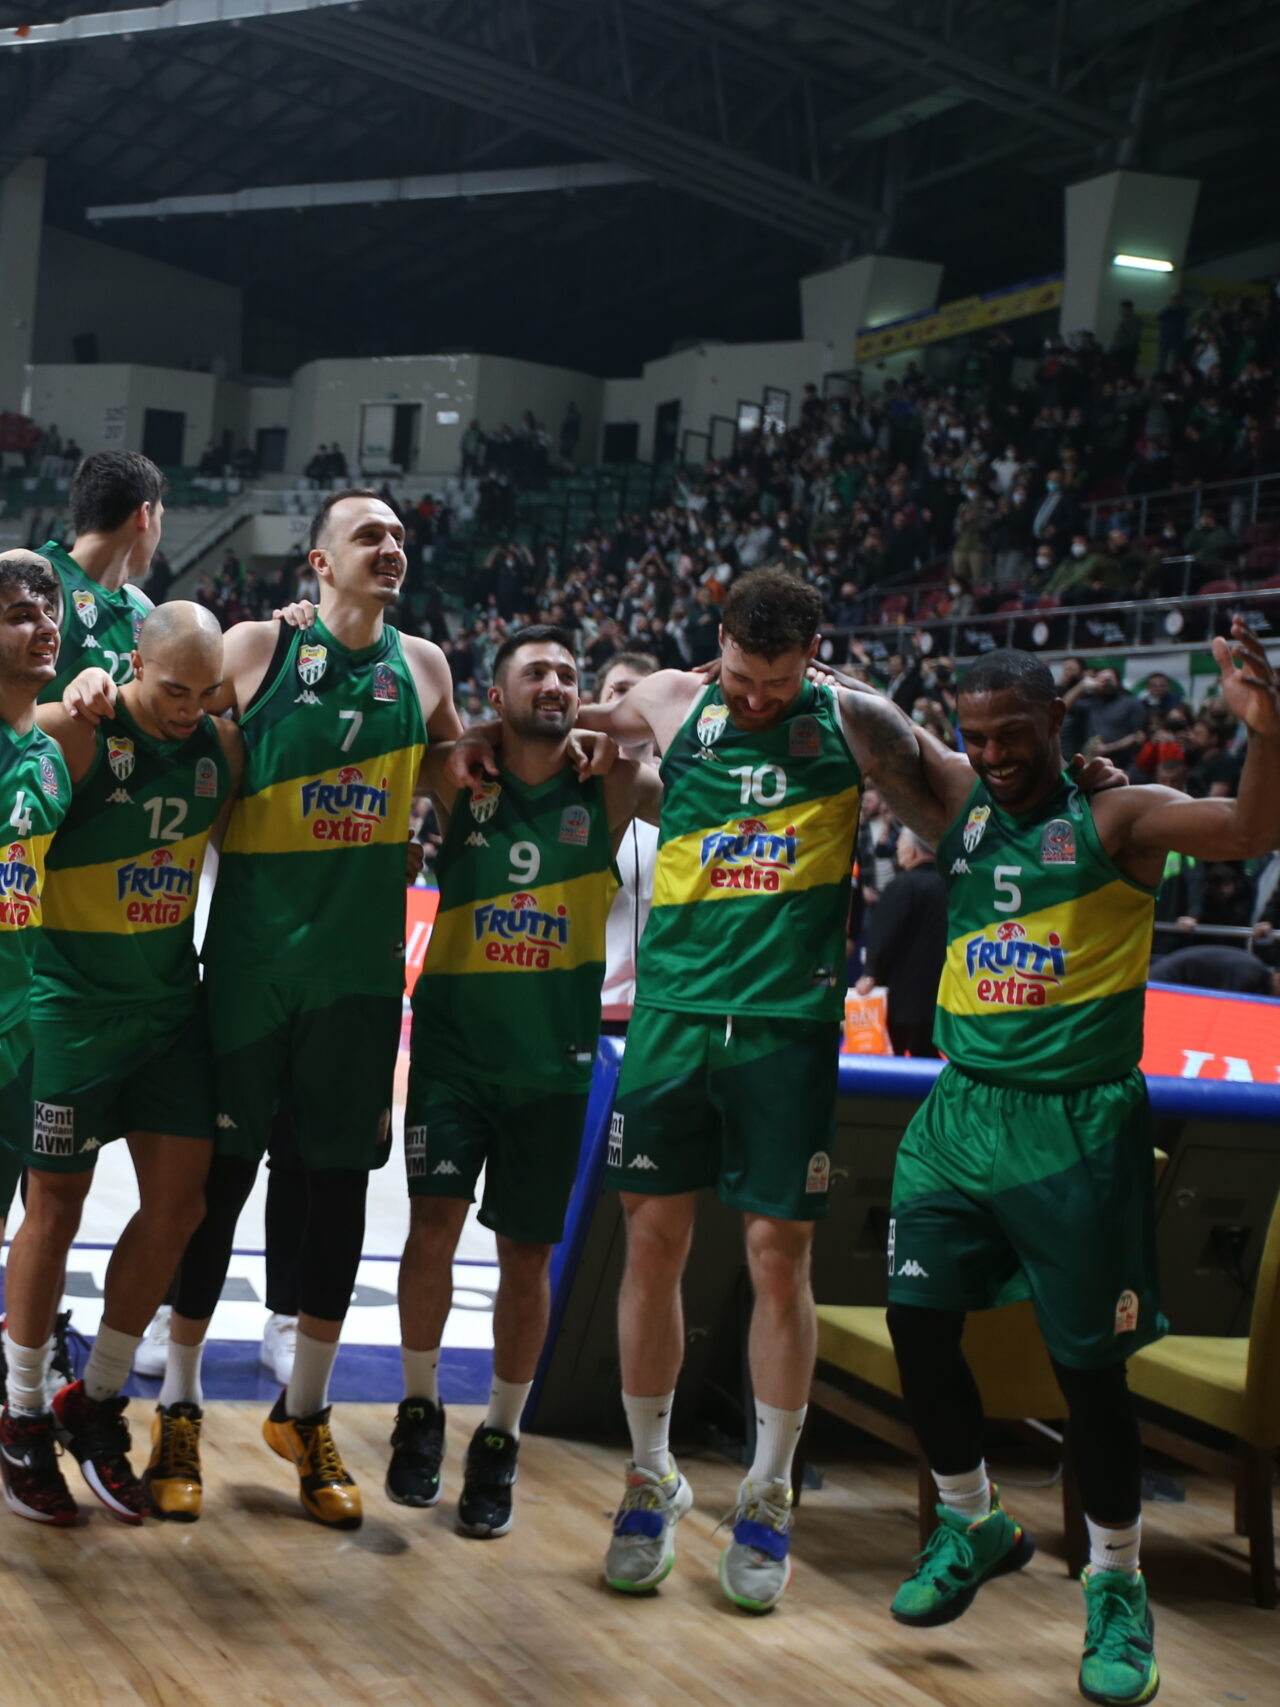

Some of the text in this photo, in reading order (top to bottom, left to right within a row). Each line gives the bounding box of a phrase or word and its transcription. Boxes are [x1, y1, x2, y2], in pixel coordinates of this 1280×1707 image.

[339, 710, 363, 752] 7
[728, 764, 787, 807] 10
[9, 791, 32, 836] 4
[143, 796, 188, 840] 12
[312, 817, 372, 843] extra
[508, 841, 541, 884] 9
[710, 865, 781, 892] extra
[993, 865, 1022, 913] 5
[126, 899, 180, 925] extra
[485, 941, 550, 969] extra
[977, 976, 1046, 1006] extra
[35, 1101, 72, 1126] Kent
[34, 1135, 71, 1155] AVM
